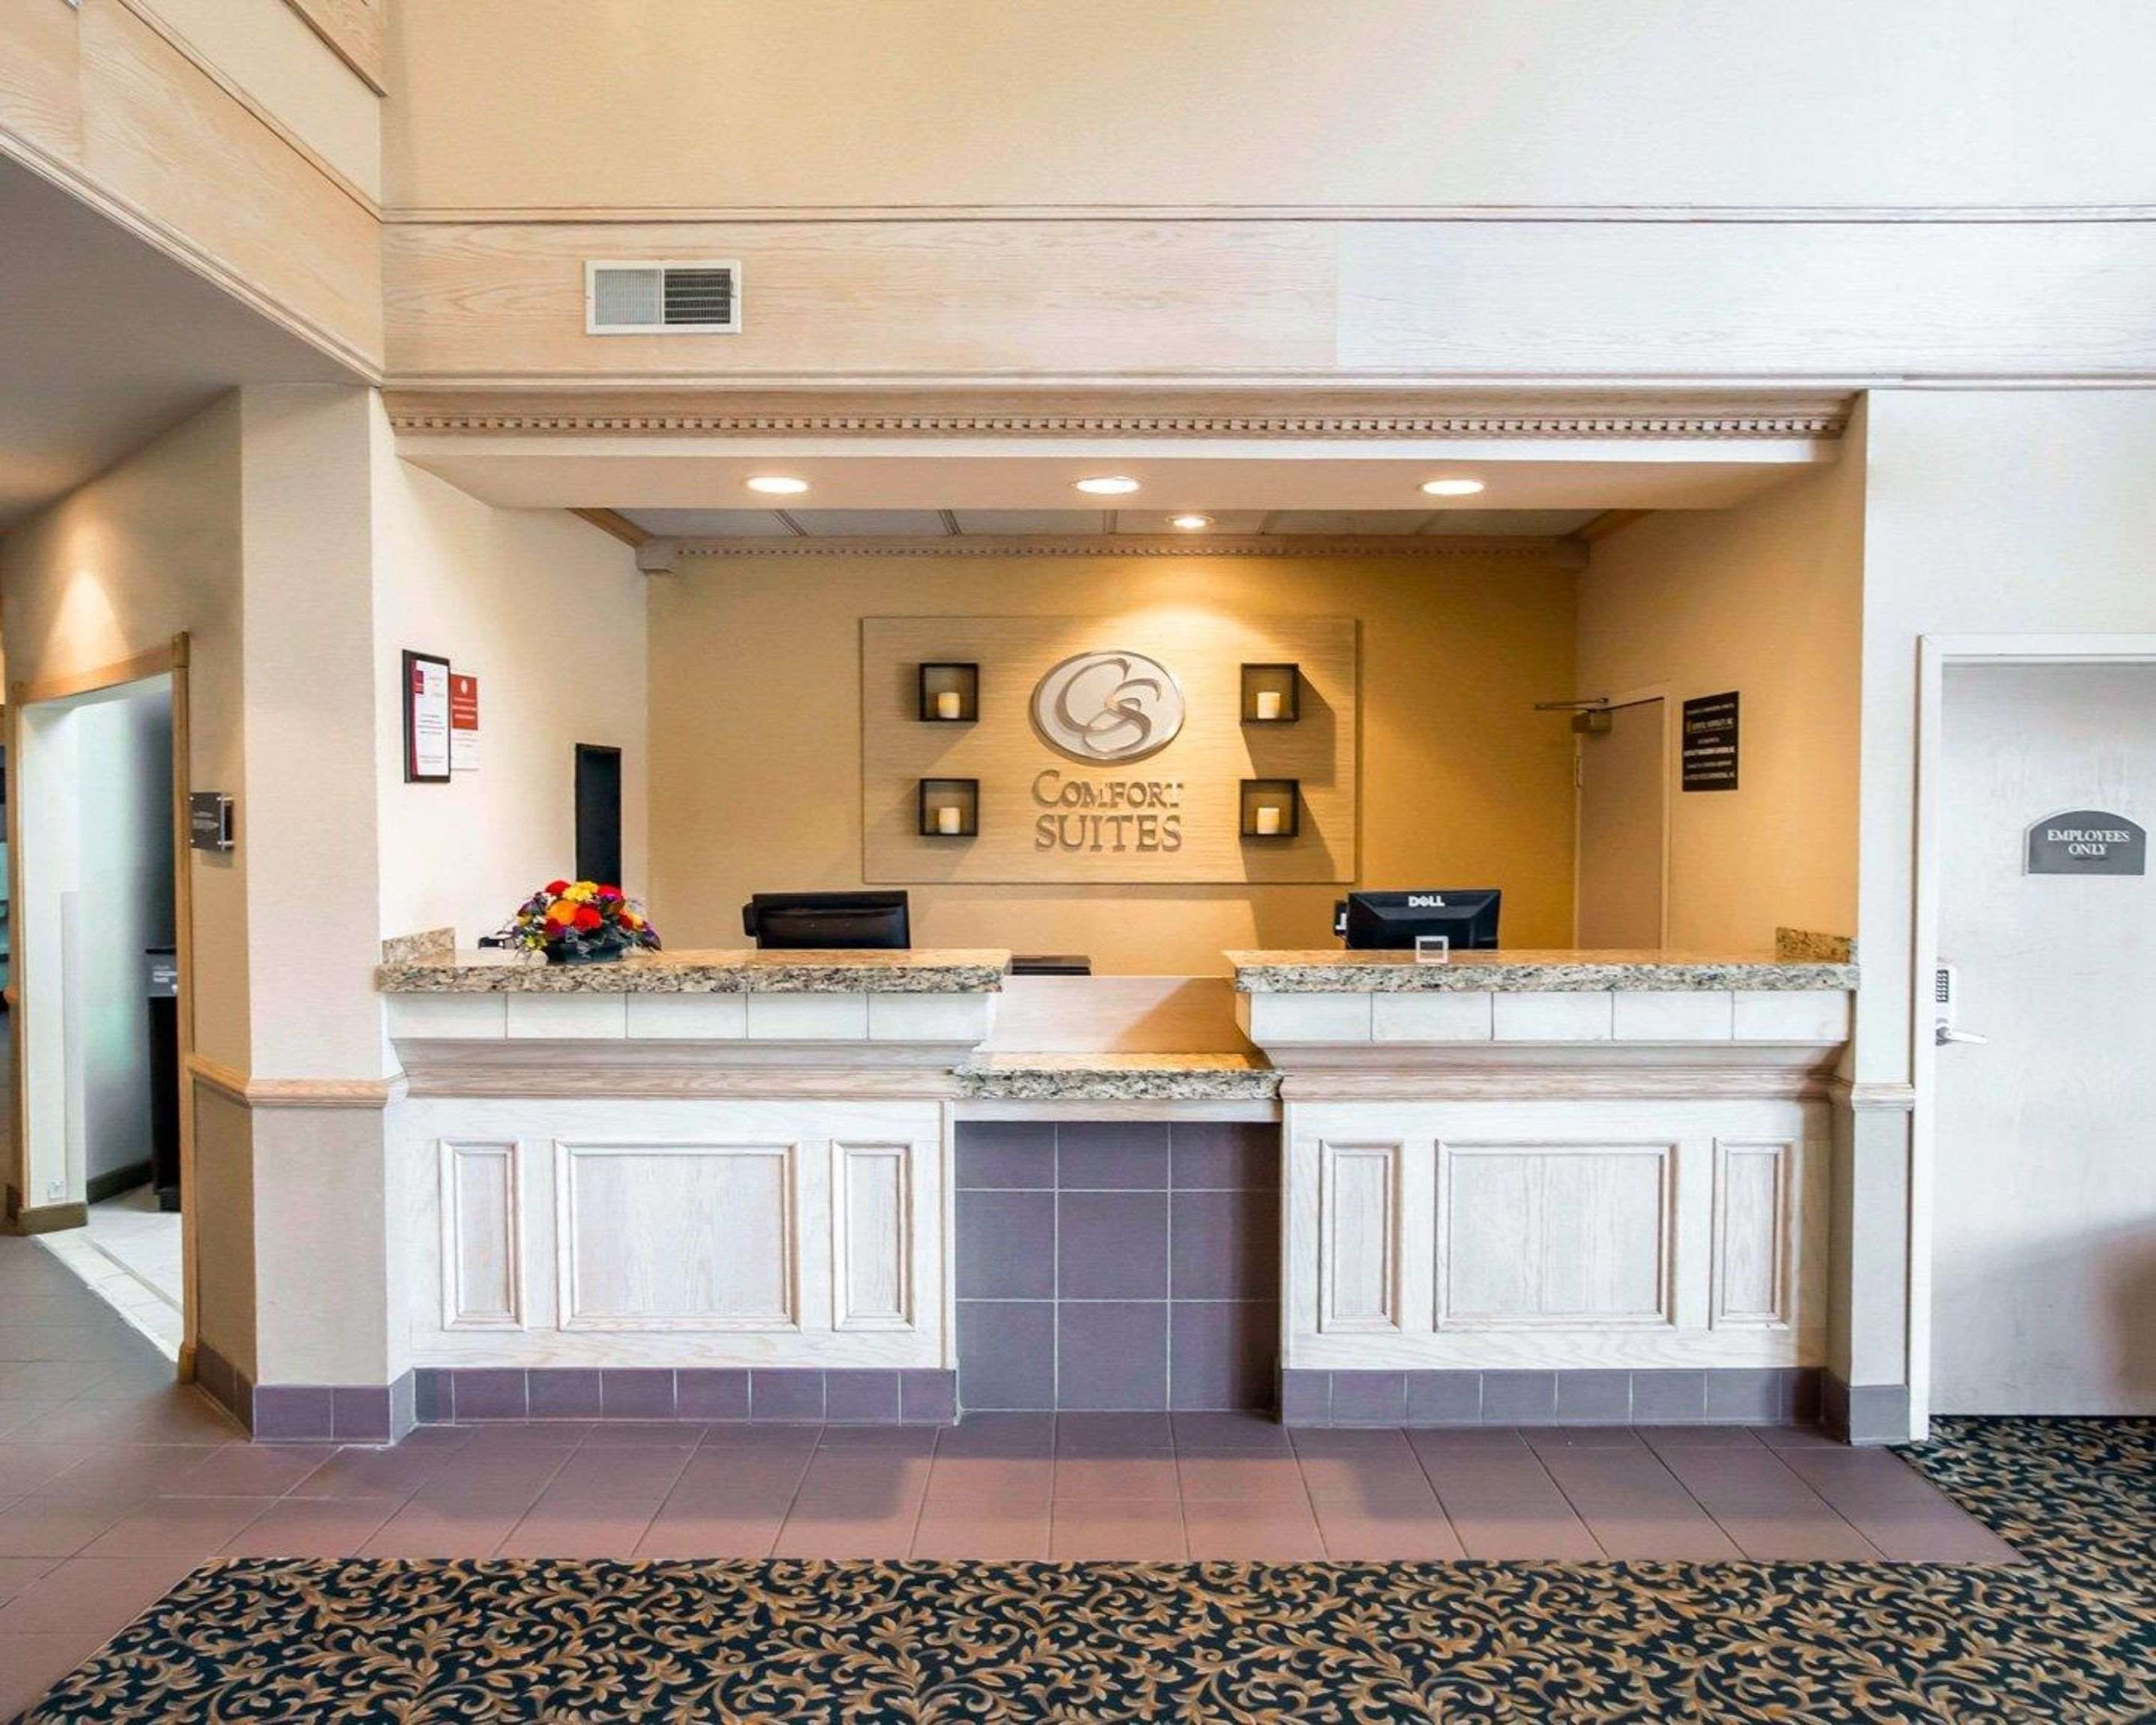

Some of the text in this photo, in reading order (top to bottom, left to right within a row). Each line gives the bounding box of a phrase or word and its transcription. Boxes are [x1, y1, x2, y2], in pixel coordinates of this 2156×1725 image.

[1035, 814, 1183, 853] SUITES
[2047, 829, 2131, 842] EMPLOYEES
[2068, 842, 2108, 855] ONLY
[1408, 895, 1446, 907] DELL
